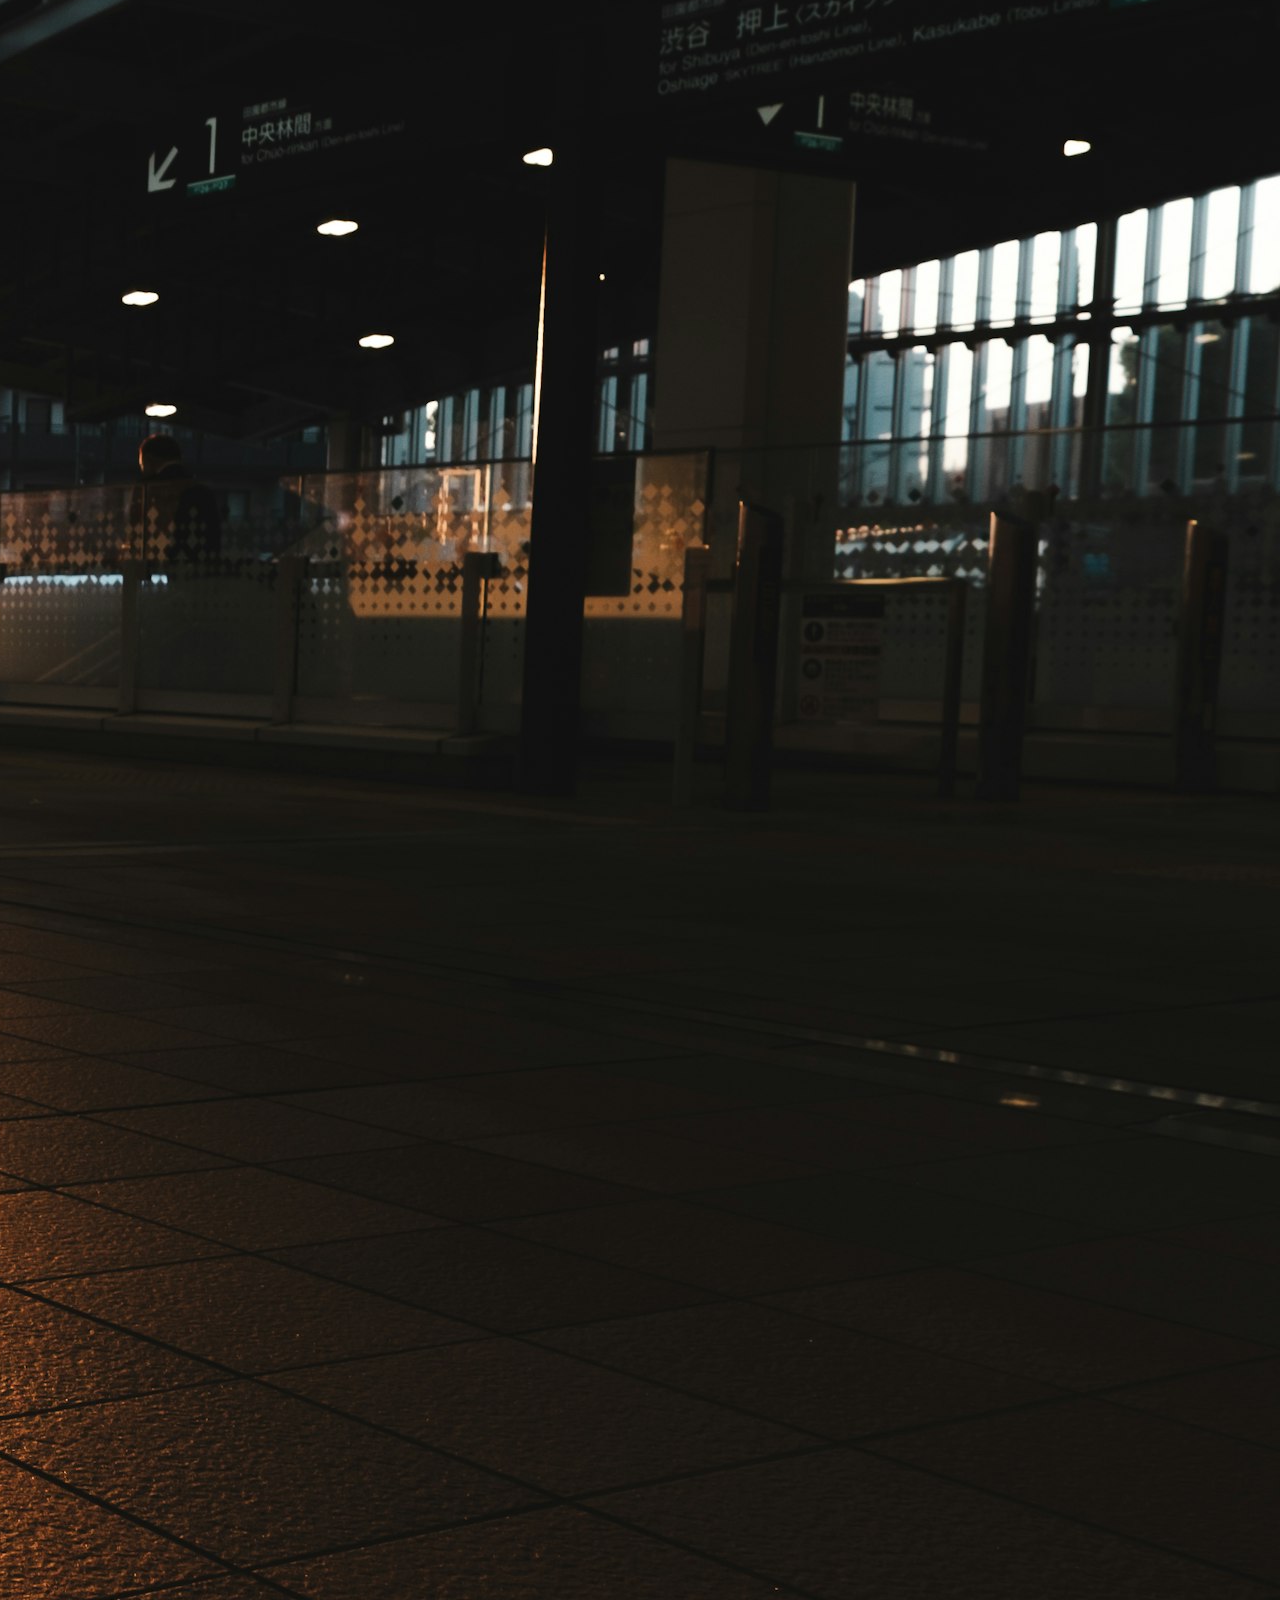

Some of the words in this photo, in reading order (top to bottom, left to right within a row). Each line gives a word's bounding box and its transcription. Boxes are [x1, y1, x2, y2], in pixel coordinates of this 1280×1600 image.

[657, 71, 719, 96] Oshiage
[912, 11, 1002, 43] Kasukabe
[1006, 4, 1049, 24] (Tobu
[659, 20, 712, 55] 渋谷
[658, 61, 678, 77] for
[681, 47, 741, 72] Shibuya
[849, 90, 915, 122] 中央林間
[204, 116, 218, 175] 1
[241, 112, 312, 148] 中央林間
